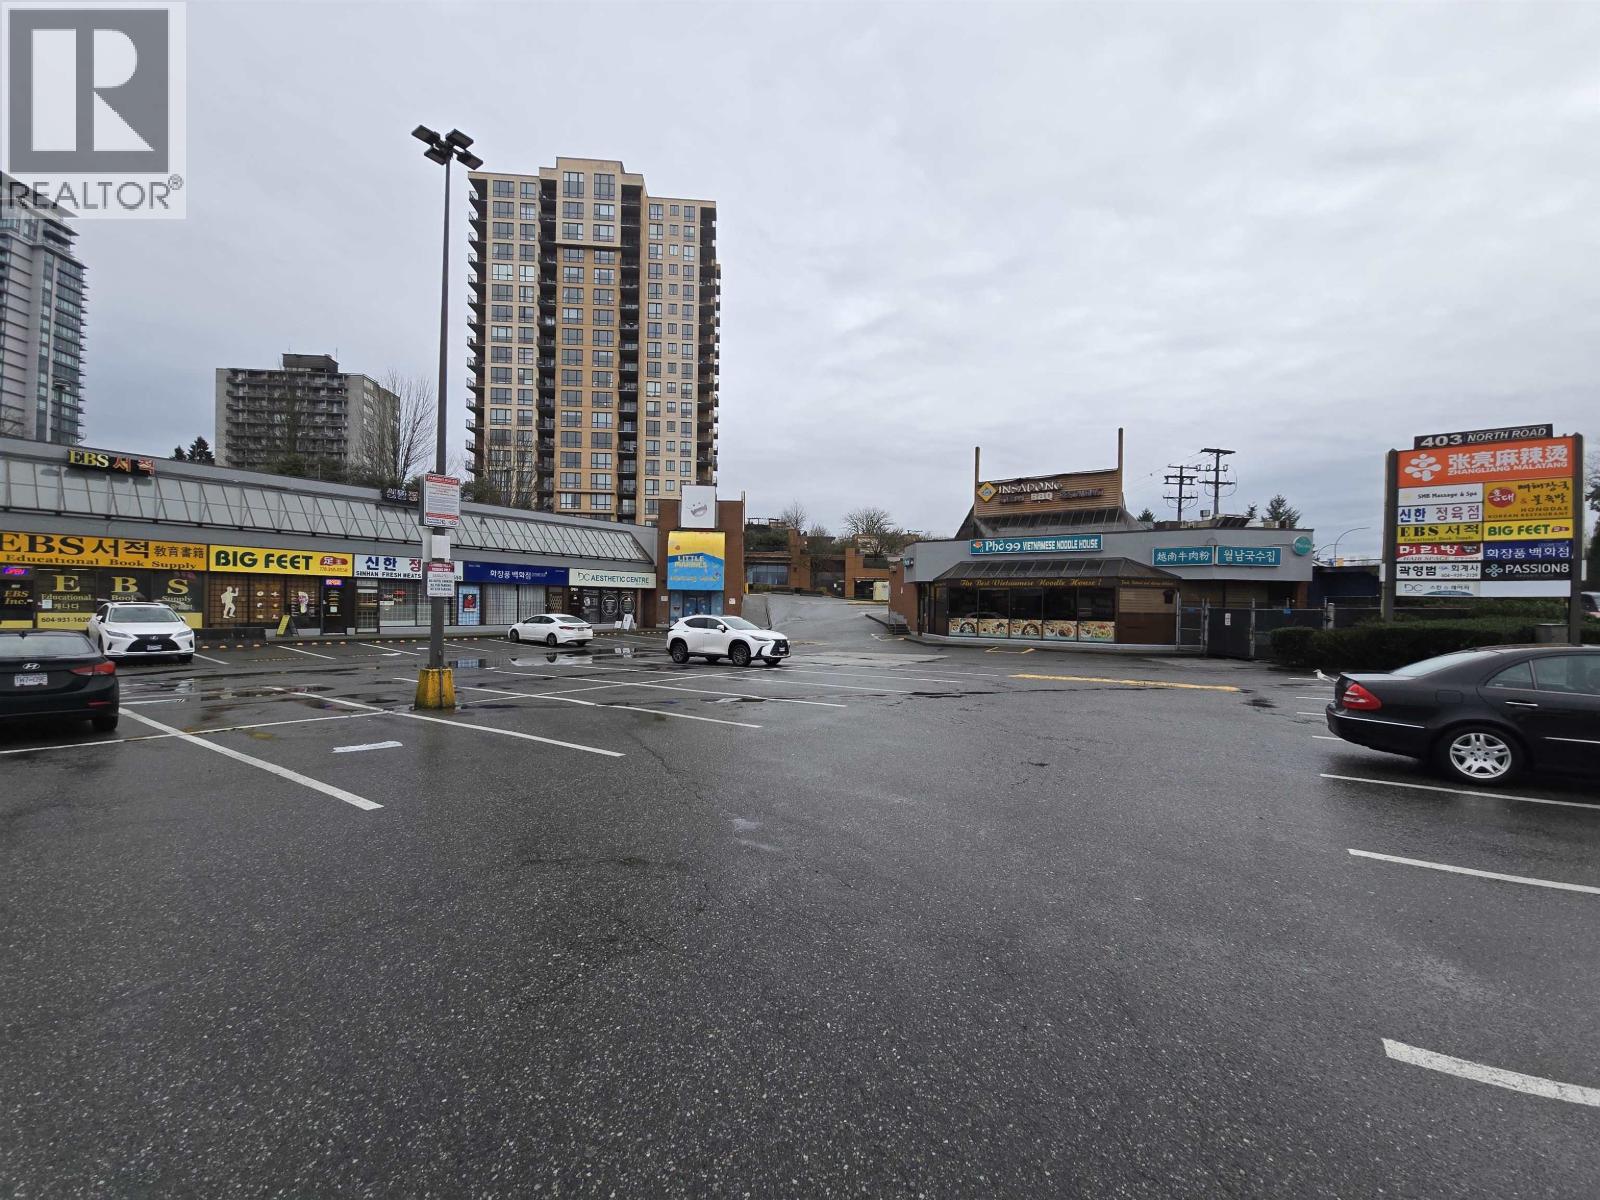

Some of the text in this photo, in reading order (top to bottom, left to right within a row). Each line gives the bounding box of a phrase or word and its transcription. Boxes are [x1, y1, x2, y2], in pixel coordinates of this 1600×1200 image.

[1420, 427, 1547, 448] 403 NORTH ROAD
[68, 449, 109, 468] EBS
[1447, 445, 1568, 469] 张亮麻辣烫
[1399, 505, 1480, 523] 신한 정육점
[1400, 524, 1479, 537] EBS 서적
[1487, 526, 1514, 536] BIG
[1517, 524, 1550, 535] FEET
[1056, 539, 1078, 550] NOODLE
[1079, 538, 1098, 549] HOUSE
[1156, 550, 1210, 562] 越南牛肉粉
[1223, 549, 1276, 563] 월남국수집
[1485, 547, 1526, 559] 화장품
[6, 554, 197, 570] Educational Book Supply
[215, 550, 313, 571] BIG FEET
[366, 556, 398, 571] 신한
[1505, 563, 1570, 574] PASSION8
[52, 574, 189, 595] E B S
[591, 574, 625, 583] AESTHETIC
[626, 576, 649, 584] CENTRE
[4, 590, 29, 598] EBS
[41, 593, 92, 601] Educational
[162, 595, 193, 603] Supply
